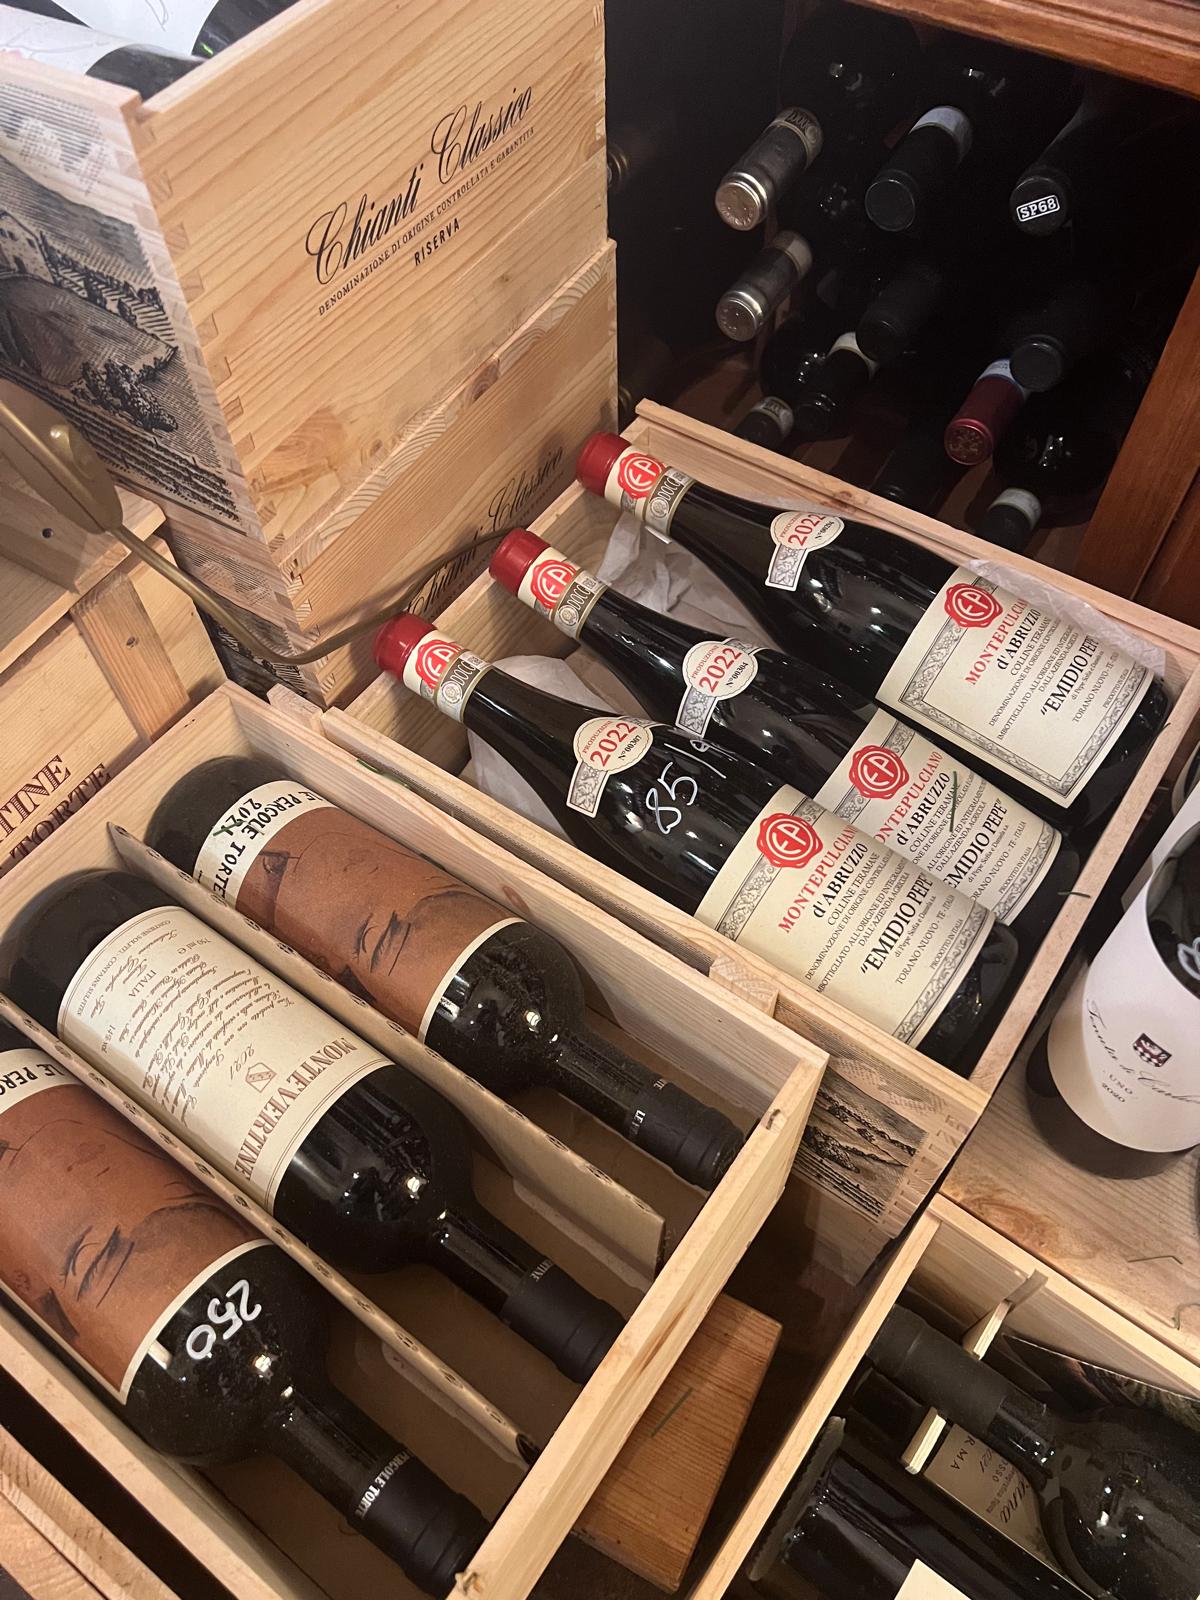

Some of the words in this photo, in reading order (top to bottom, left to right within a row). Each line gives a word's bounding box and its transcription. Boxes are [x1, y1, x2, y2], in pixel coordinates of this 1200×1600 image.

[305, 163, 424, 285] Chianti
[431, 86, 532, 185] Classico
[1020, 197, 1057, 219] SP68
[318, 250, 390, 316] DENOMINAZIONE
[391, 241, 400, 255] DI
[402, 211, 435, 244] ORIGINE
[436, 165, 489, 215] CONTROLLATA
[489, 160, 496, 169] E
[495, 127, 534, 163] GARANTITA
[413, 217, 460, 266] RISERVA
[785, 505, 826, 550] 2022
[696, 641, 742, 695] 2022
[1009, 642, 1035, 677] COLLINE
[988, 671, 1027, 728] DENOMINAZIONE
[996, 690, 1033, 742] IMBOTTIGLIATO
[1071, 691, 1096, 724] TORANO
[587, 714, 637, 770] 2022
[858, 750, 900, 792] EP
[241, 793, 304, 840] PERGOLE
[645, 761, 698, 834] 85
[873, 749, 945, 846] ONTEPULCIANO
[769, 819, 810, 863] EP
[907, 816, 938, 855] COLLINE
[926, 816, 949, 845] ORIGINE
[212, 841, 246, 900] TORTE
[987, 848, 1010, 878] NUOVO
[825, 885, 857, 927] COLLINE
[850, 850, 881, 890] TERAMANE
[803, 921, 846, 981] DENOMINAZIONE
[840, 912, 851, 925] DI
[846, 886, 869, 916] ORIGINE
[894, 947, 923, 986] TORANO
[915, 921, 940, 951] NUOVO
[897, 934, 913, 952] Pepe
[128, 969, 156, 997] ITALIA
[229, 1043, 256, 1080] 2021
[1108, 1072, 1134, 1096] UNO
[234, 1036, 358, 1181] MONTEVERTINE
[186, 1279, 262, 1361] 250
